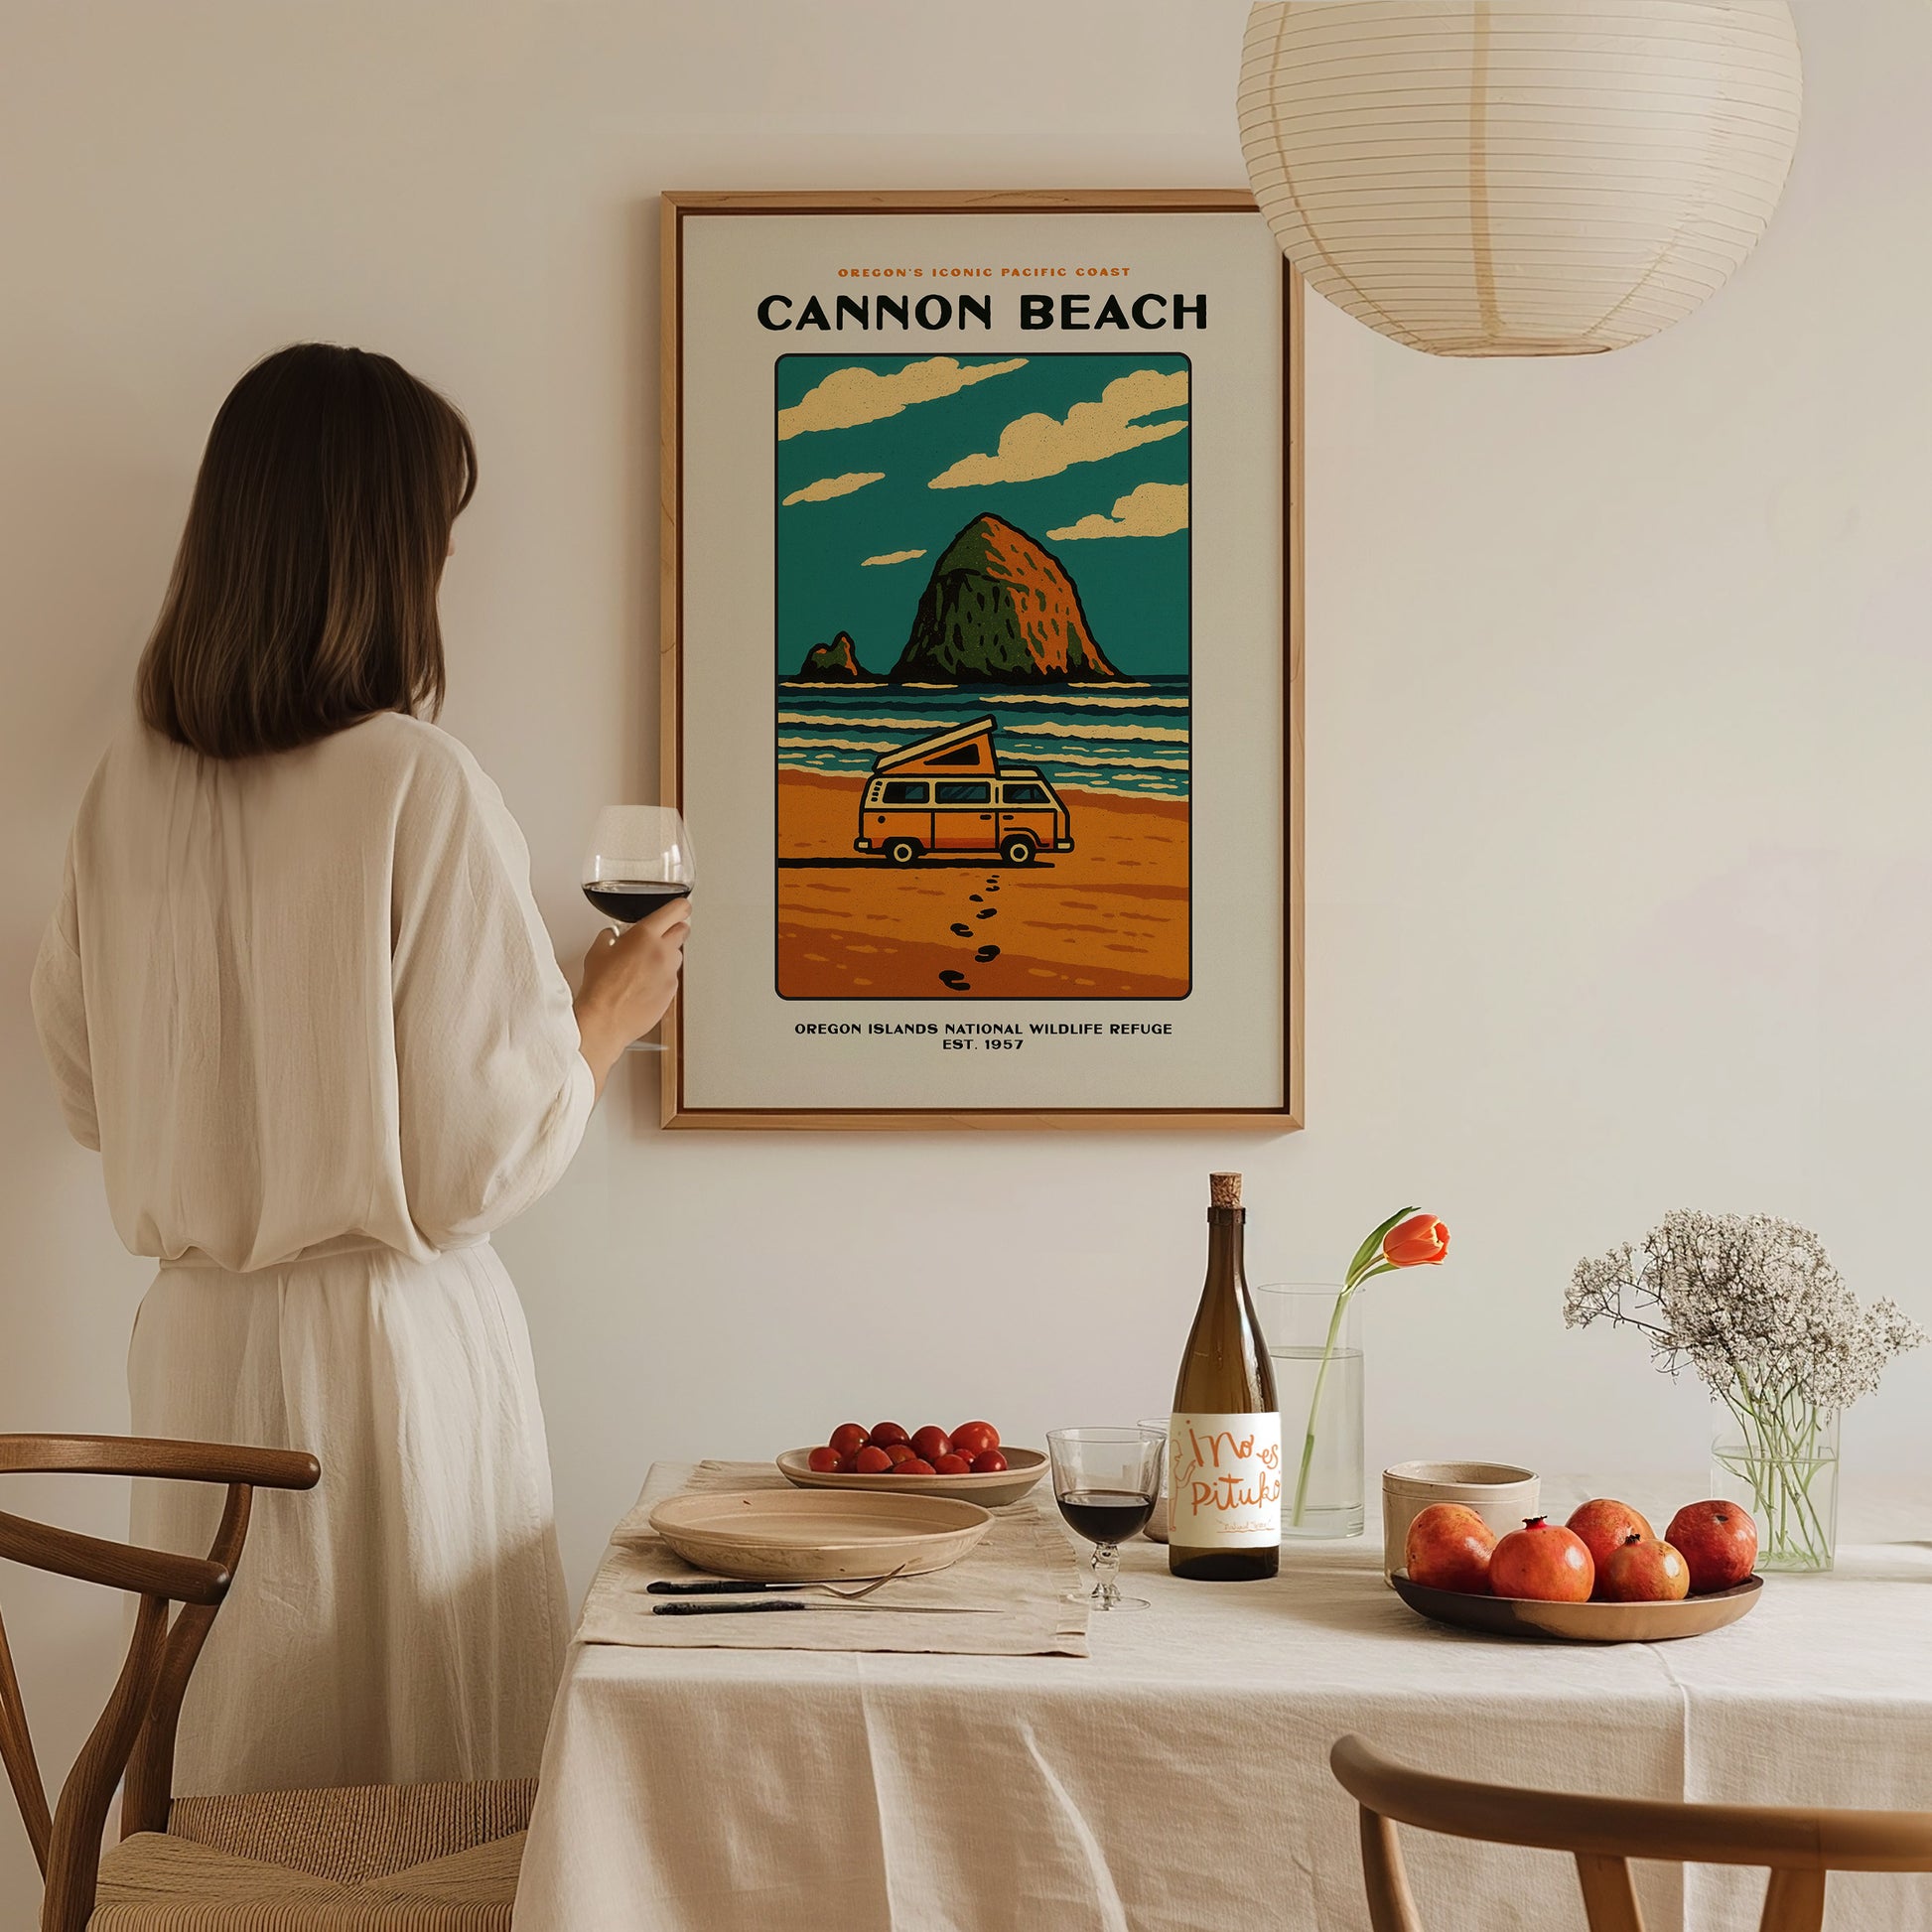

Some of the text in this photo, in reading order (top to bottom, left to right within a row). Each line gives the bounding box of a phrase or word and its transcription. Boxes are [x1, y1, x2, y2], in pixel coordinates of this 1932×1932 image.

[837, 266, 1131, 279] OREGON'S ICONIC PACIFIC COAST
[757, 293, 1207, 332] CANNON BEACH
[794, 1023, 1173, 1035] OREGON ISLANDS NATIONAL WILDLIFE REFUGE
[942, 1038, 1024, 1050] EST. 1957
[1256, 1444, 1280, 1470] es
